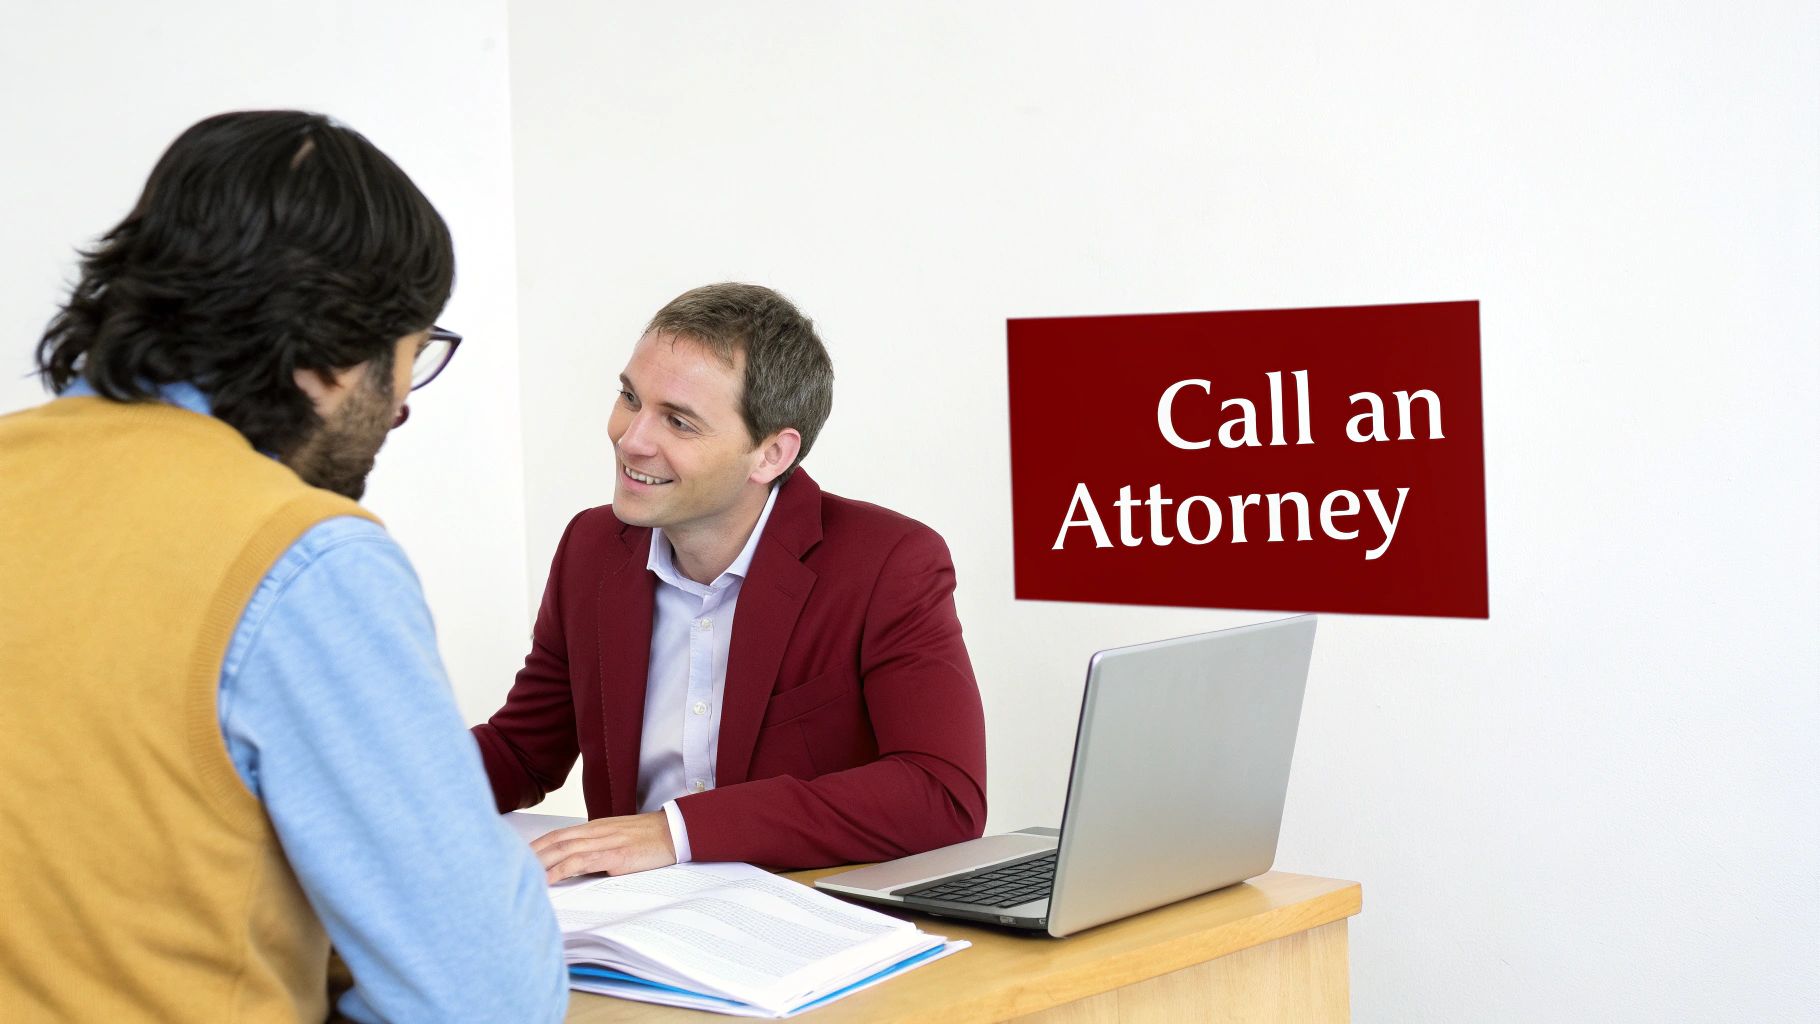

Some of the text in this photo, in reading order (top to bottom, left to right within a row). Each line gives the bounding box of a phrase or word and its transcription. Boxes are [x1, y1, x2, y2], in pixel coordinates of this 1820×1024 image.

[1157, 369, 1446, 450] Call an
[1051, 482, 1411, 561] Attorney
